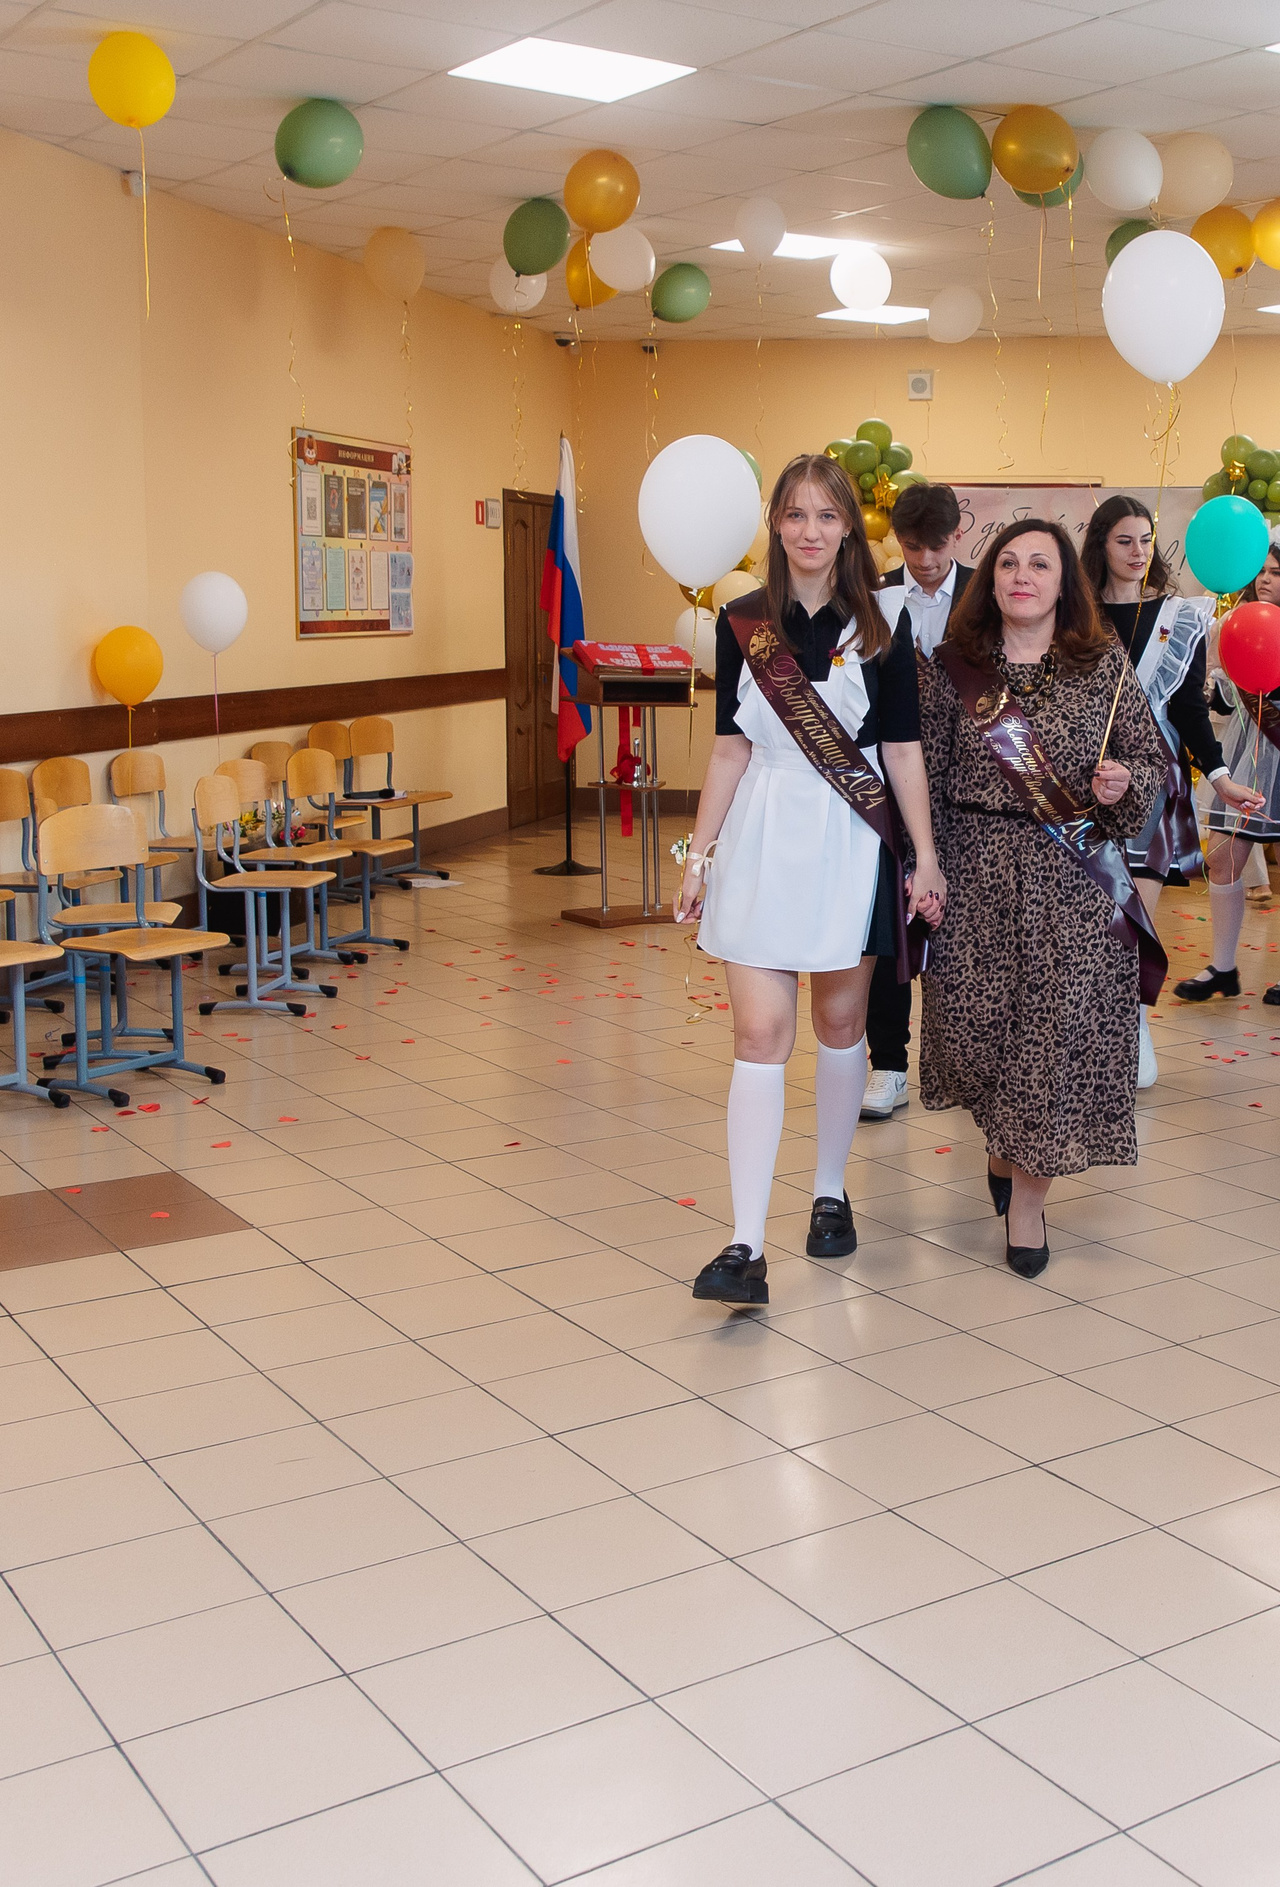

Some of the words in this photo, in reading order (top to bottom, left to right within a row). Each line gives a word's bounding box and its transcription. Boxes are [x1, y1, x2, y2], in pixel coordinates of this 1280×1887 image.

[766, 655, 851, 773] Выпускница
[838, 764, 887, 810] 2024
[999, 713, 1050, 784] Классный
[1003, 755, 1065, 826] руководитель
[1059, 812, 1104, 859] 2024
